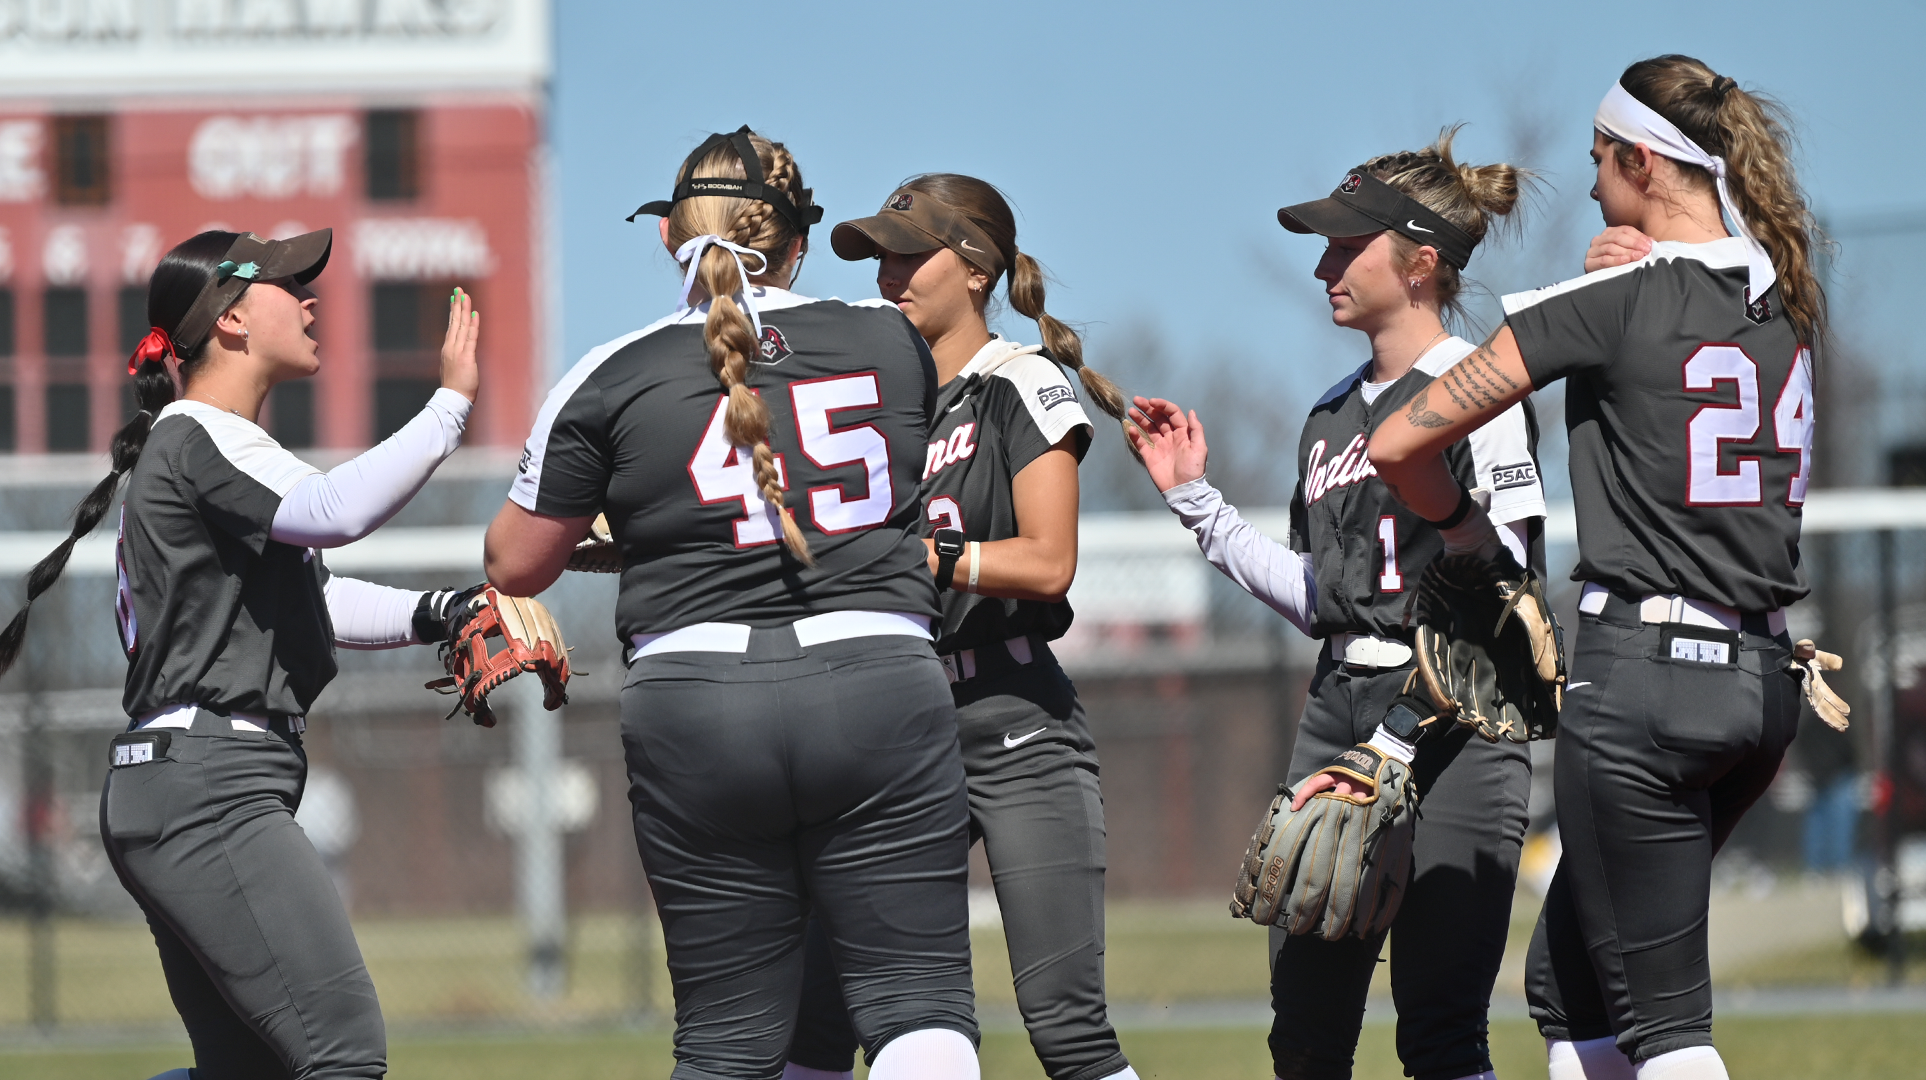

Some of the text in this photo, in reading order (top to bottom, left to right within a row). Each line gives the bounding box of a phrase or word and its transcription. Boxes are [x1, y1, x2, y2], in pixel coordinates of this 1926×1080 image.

[188, 115, 356, 199] OUT
[687, 371, 896, 549] 45
[1681, 341, 1816, 507] 24
[1493, 468, 1535, 484] PSAC
[1377, 514, 1403, 593] 1
[1262, 856, 1285, 905] A2000
